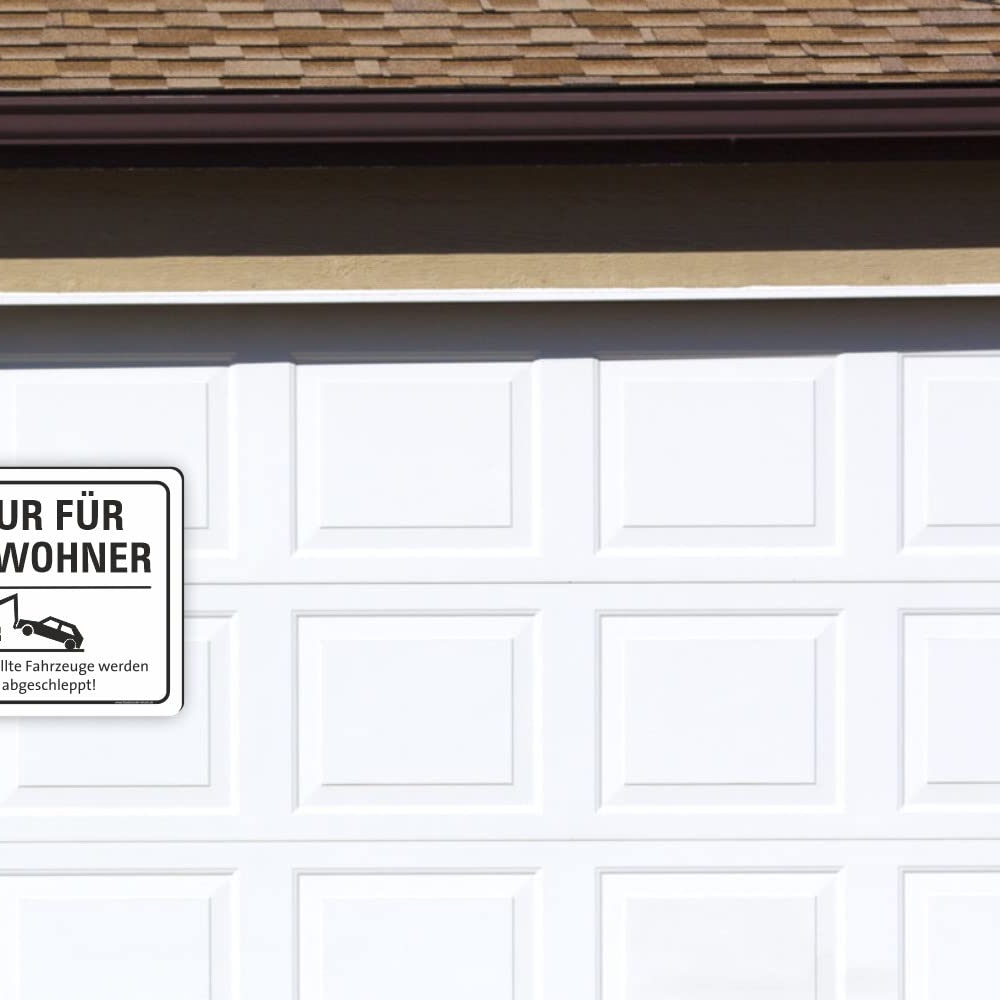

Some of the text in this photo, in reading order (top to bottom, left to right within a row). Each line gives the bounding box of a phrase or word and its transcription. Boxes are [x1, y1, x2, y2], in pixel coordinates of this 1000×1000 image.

[56, 490, 124, 531] FÜR
[25, 659, 95, 676] Fahrzeuge
[98, 659, 149, 672] werden
[2, 678, 96, 695] abgeschleppt!
